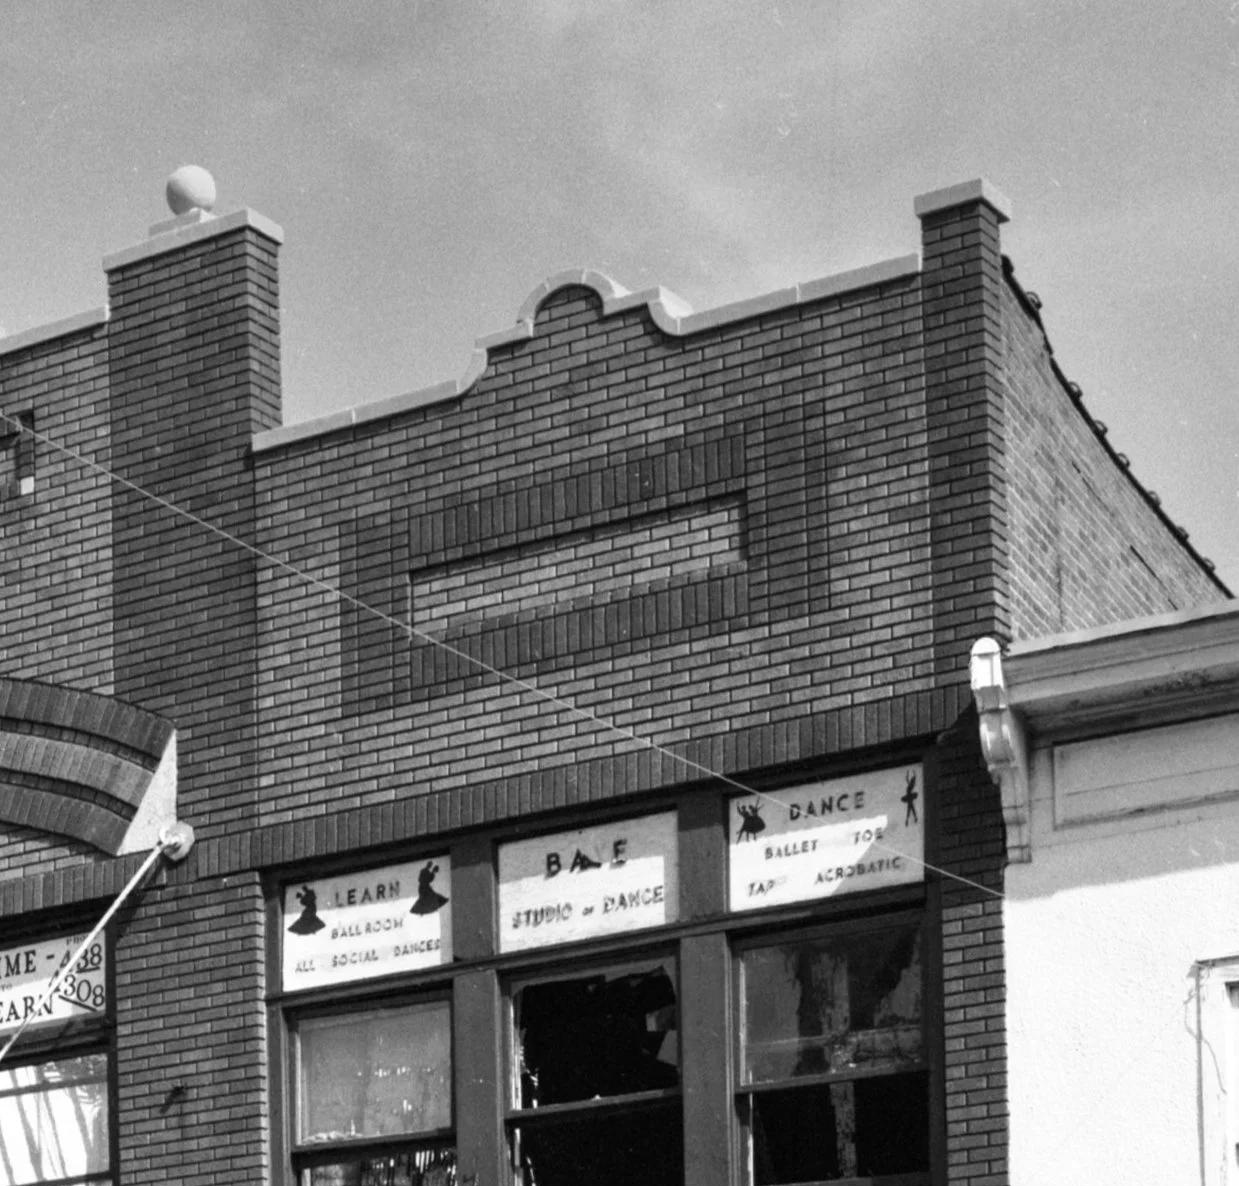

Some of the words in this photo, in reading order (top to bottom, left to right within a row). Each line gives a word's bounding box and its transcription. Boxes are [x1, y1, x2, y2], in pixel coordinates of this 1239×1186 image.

[789, 791, 865, 821] DANCE
[545, 838, 628, 877] BAE
[764, 839, 819, 860] BALLET
[748, 880, 776, 897] TAP
[814, 856, 902, 885] ACROBATIC
[334, 880, 400, 908] LEARN
[512, 901, 574, 929] STUDIO
[602, 885, 664, 915] DANCE
[331, 919, 404, 940] BALLROOM
[294, 959, 316, 974] ALL
[331, 949, 379, 968] SOCIAL
[393, 938, 441, 957] DANCES
